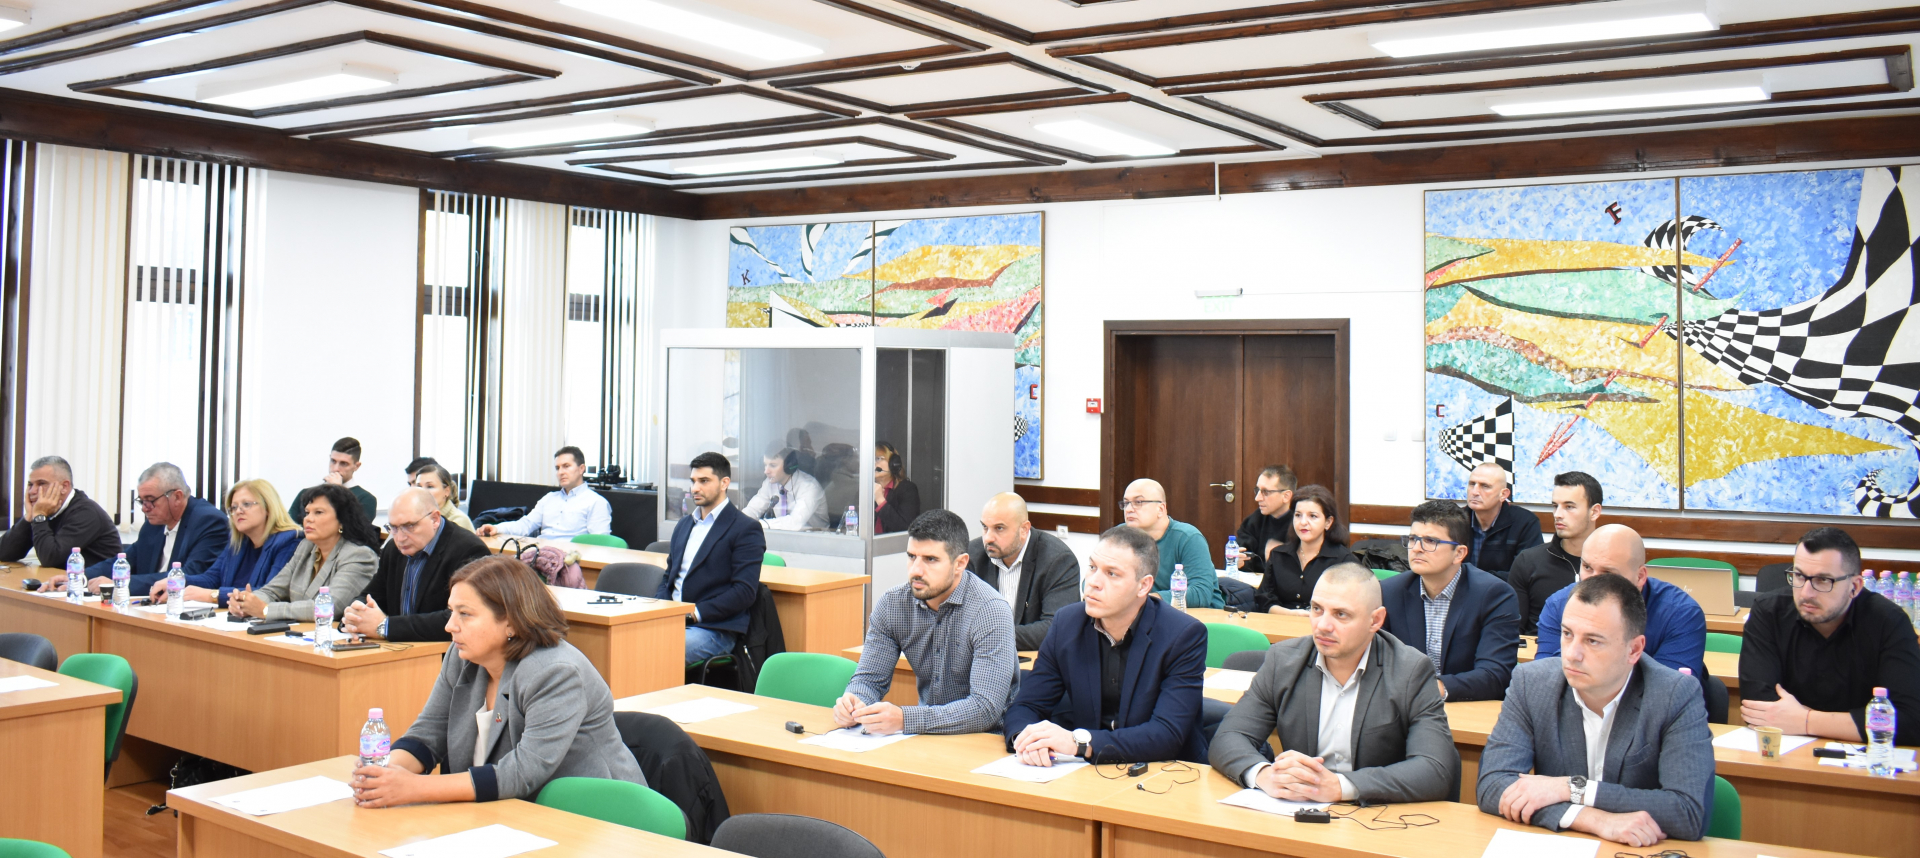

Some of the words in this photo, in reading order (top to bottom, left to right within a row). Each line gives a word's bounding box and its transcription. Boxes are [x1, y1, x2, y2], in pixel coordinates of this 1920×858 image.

[1605, 201, 1621, 225] F
[741, 269, 751, 285] K
[1204, 299, 1234, 313] EXIT
